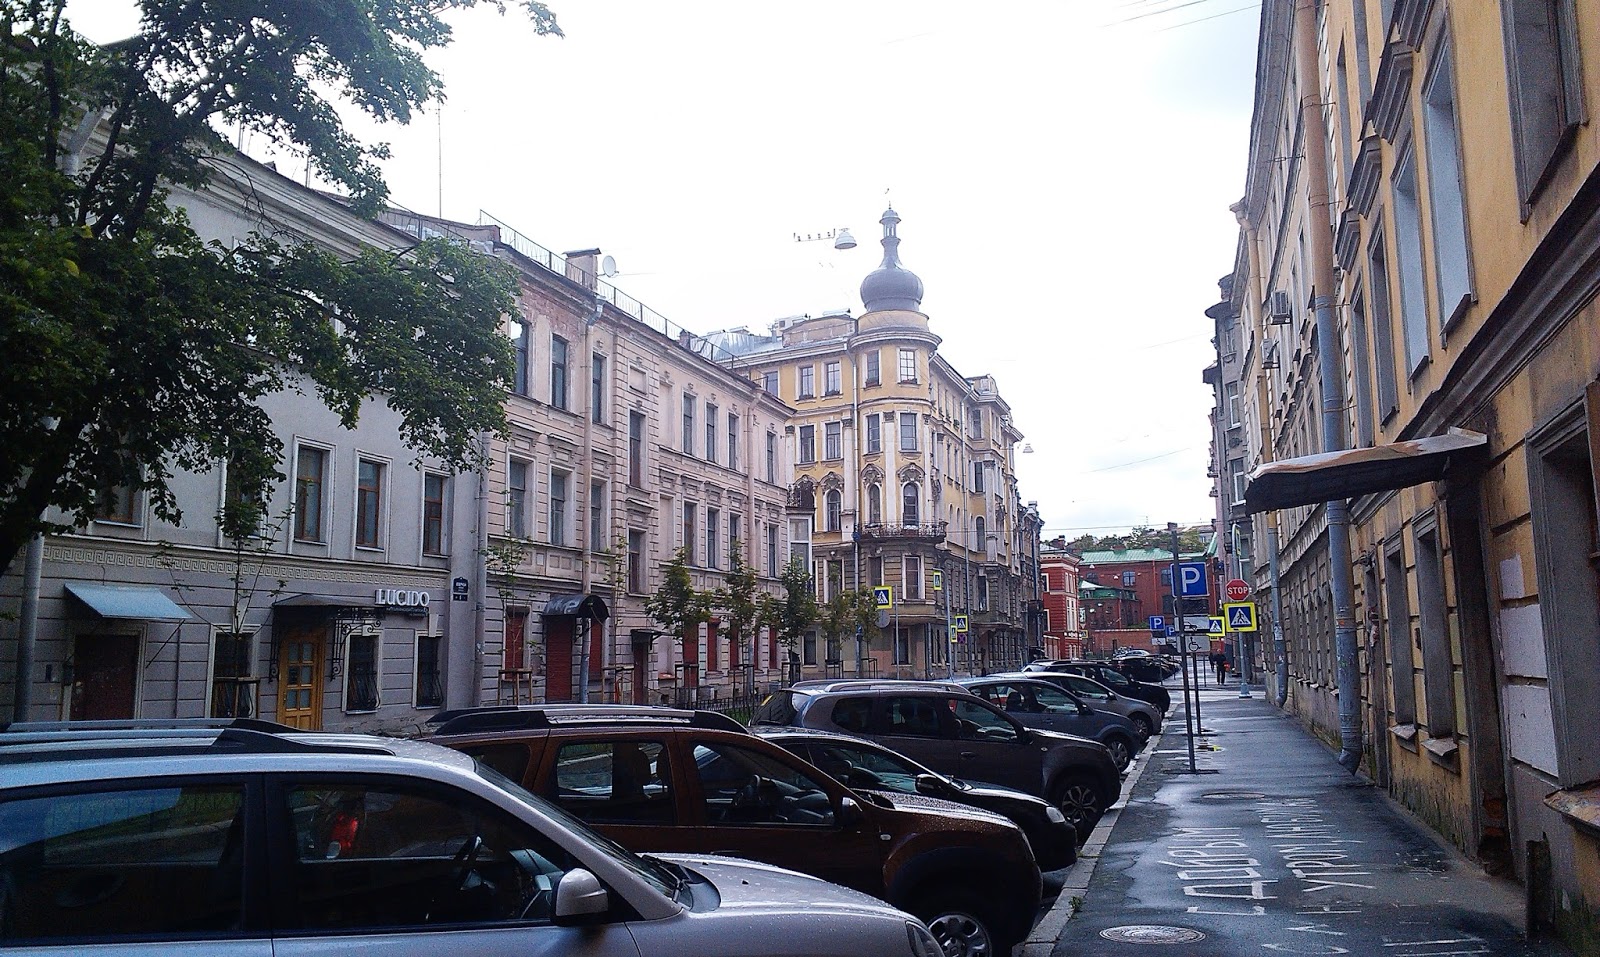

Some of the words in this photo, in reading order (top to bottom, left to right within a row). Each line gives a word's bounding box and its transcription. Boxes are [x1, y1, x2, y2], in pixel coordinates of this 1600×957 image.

[1181, 567, 1201, 593] P
[378, 588, 430, 606] LUCIDO
[1227, 586, 1248, 595] STOP
[1153, 618, 1162, 629] P
[1168, 627, 1175, 636] P
[1157, 826, 1278, 900] ДОБРЫМ
